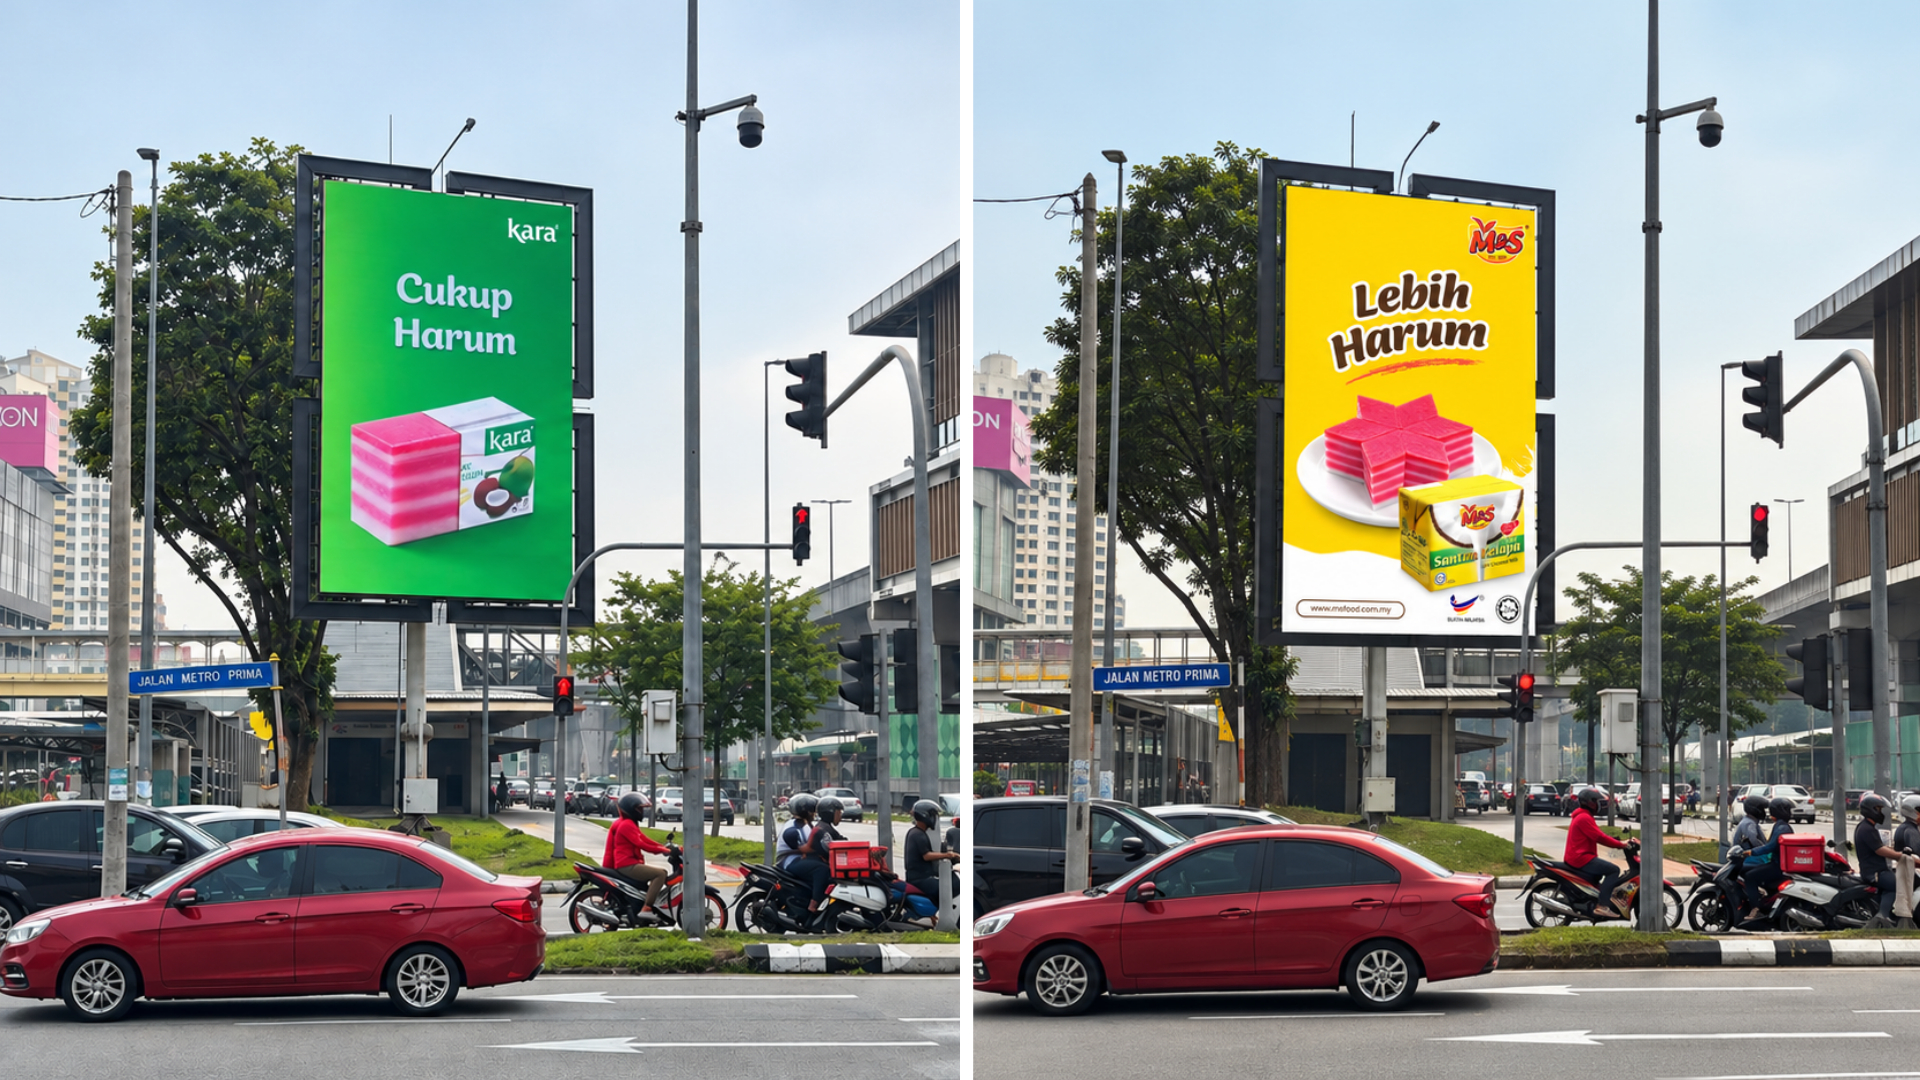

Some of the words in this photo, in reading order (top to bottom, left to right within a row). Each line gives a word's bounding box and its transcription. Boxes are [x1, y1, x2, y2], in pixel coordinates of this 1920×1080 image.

[508, 217, 557, 244] kara
[396, 272, 513, 319] Cukup
[1354, 272, 1470, 319] Lebih
[393, 316, 517, 356] Harum
[1330, 320, 1487, 370] Harum
[0, 406, 38, 428] ON
[489, 427, 533, 452] kara
[1310, 605, 1392, 615] www.msfood.com.my
[137, 673, 174, 688] JALAN
[181, 670, 220, 684] METRO
[228, 667, 263, 681] PRIMA
[1103, 671, 1140, 684] JALAN
[1143, 669, 1181, 683] METRO
[1184, 668, 1220, 681] PRIMA
